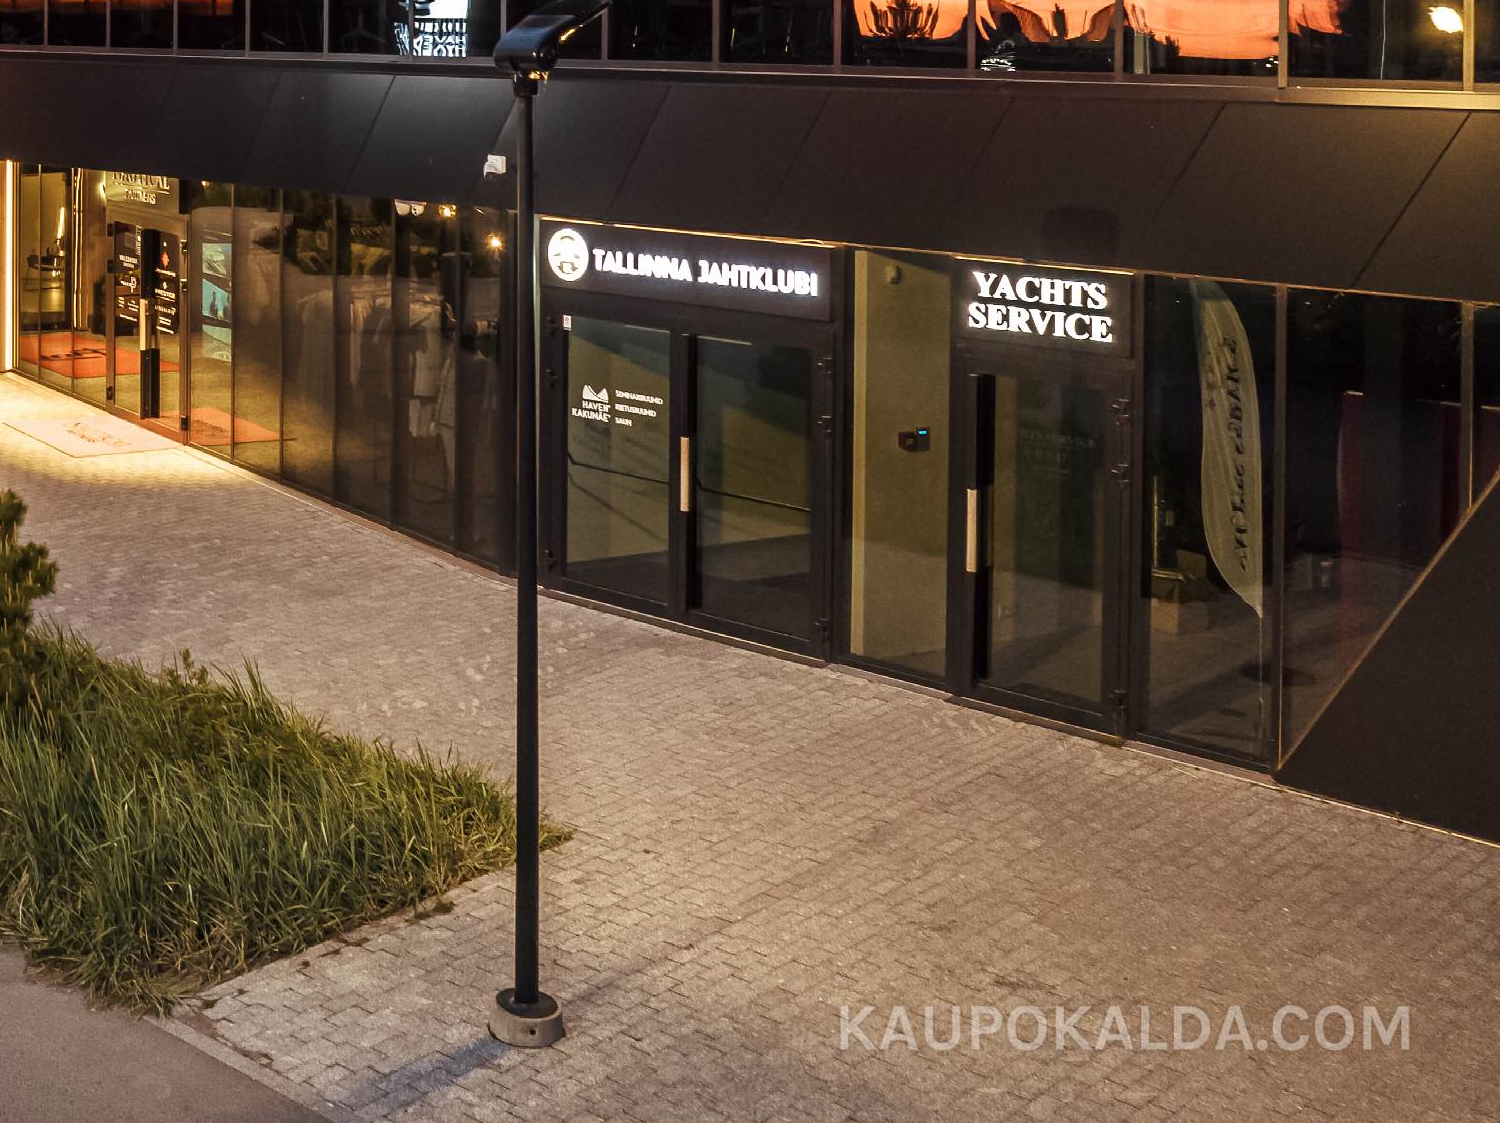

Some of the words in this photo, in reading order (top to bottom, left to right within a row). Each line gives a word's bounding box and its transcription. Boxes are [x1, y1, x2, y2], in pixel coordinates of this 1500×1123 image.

[592, 248, 693, 282] TALLINNA
[697, 259, 819, 297] JAHTKLUBI
[972, 271, 1108, 310] YACHTS
[968, 301, 1113, 343] SERVICE
[582, 400, 611, 413] HAVEN
